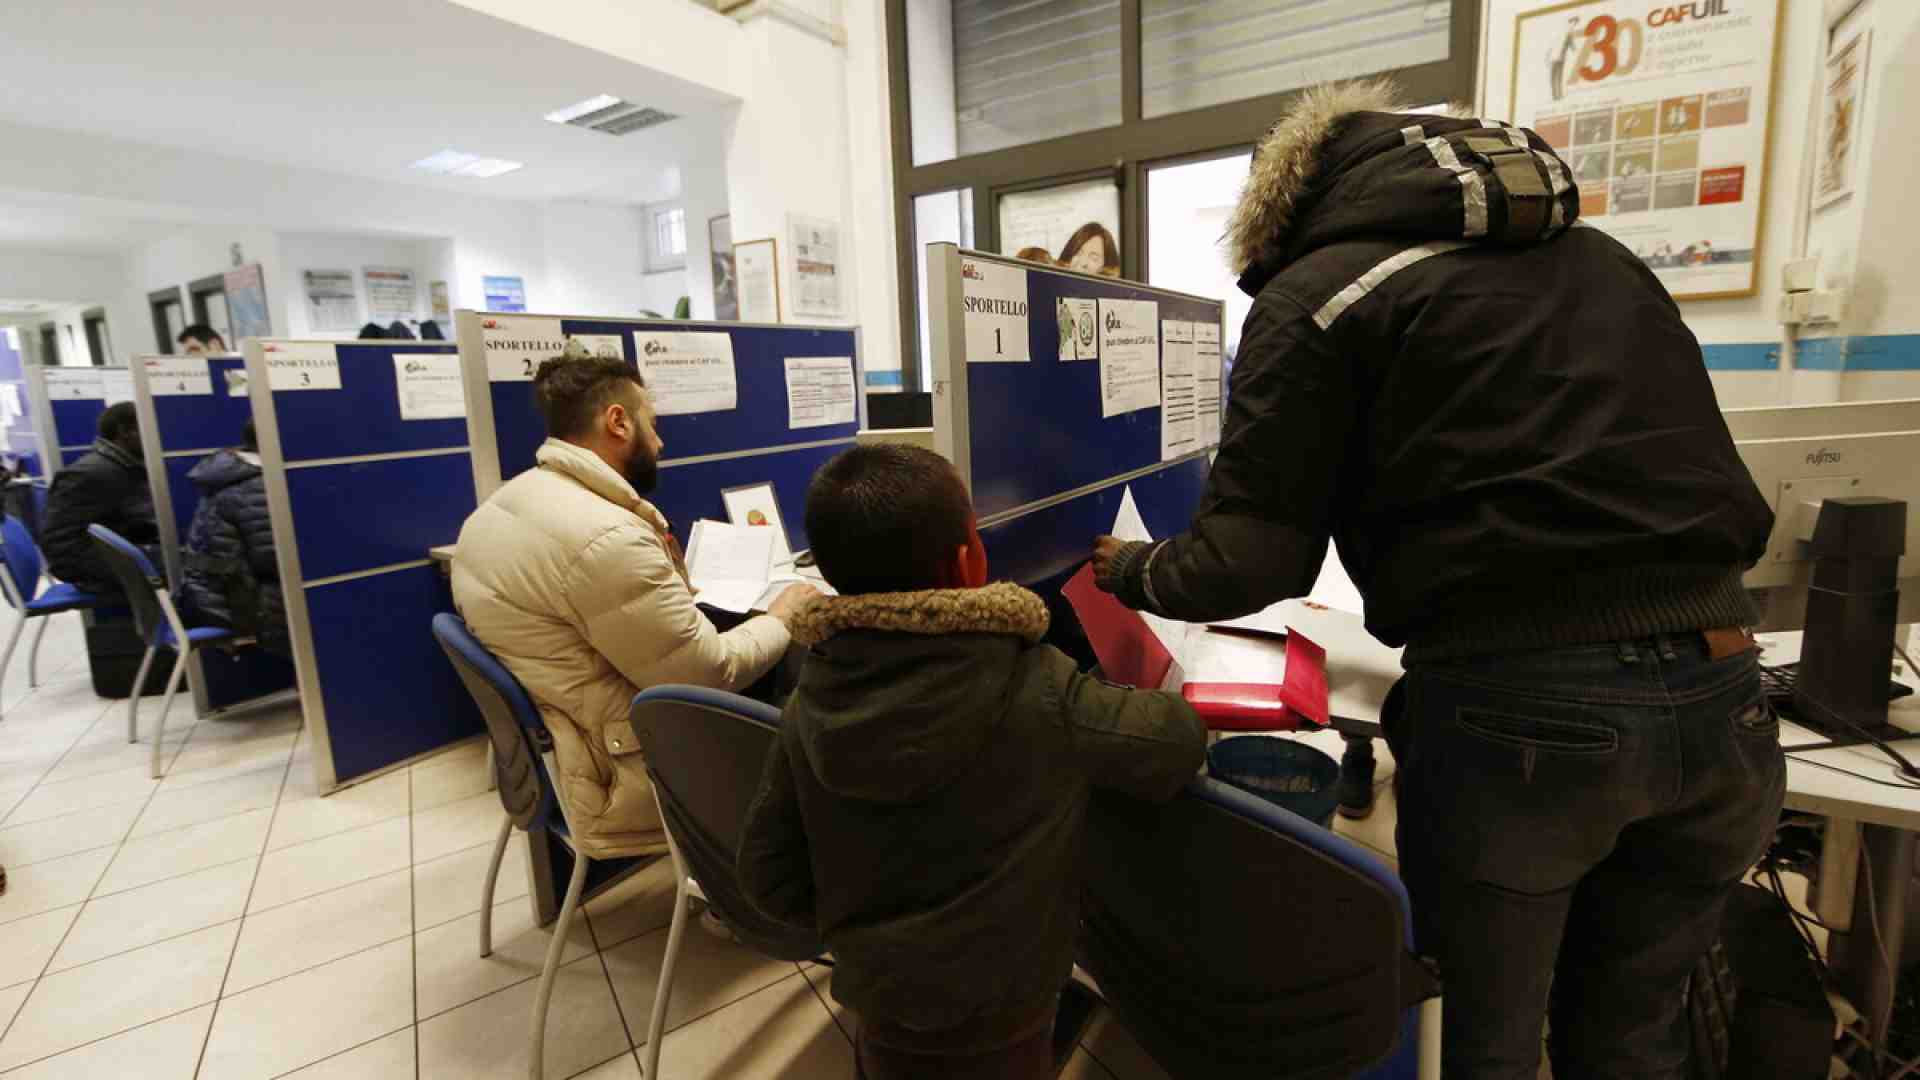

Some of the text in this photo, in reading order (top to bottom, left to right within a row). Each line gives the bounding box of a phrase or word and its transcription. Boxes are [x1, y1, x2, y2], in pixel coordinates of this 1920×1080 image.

[1578, 15, 1643, 81] 30
[964, 295, 1027, 317] SPORTELLO
[484, 340, 563, 352] SPORTELLO
[994, 327, 1003, 354] 1
[266, 359, 337, 369] SPORTELLO
[522, 358, 533, 377] 2
[299, 371, 311, 387] 3
[1806, 448, 1841, 466] FUJITSU
